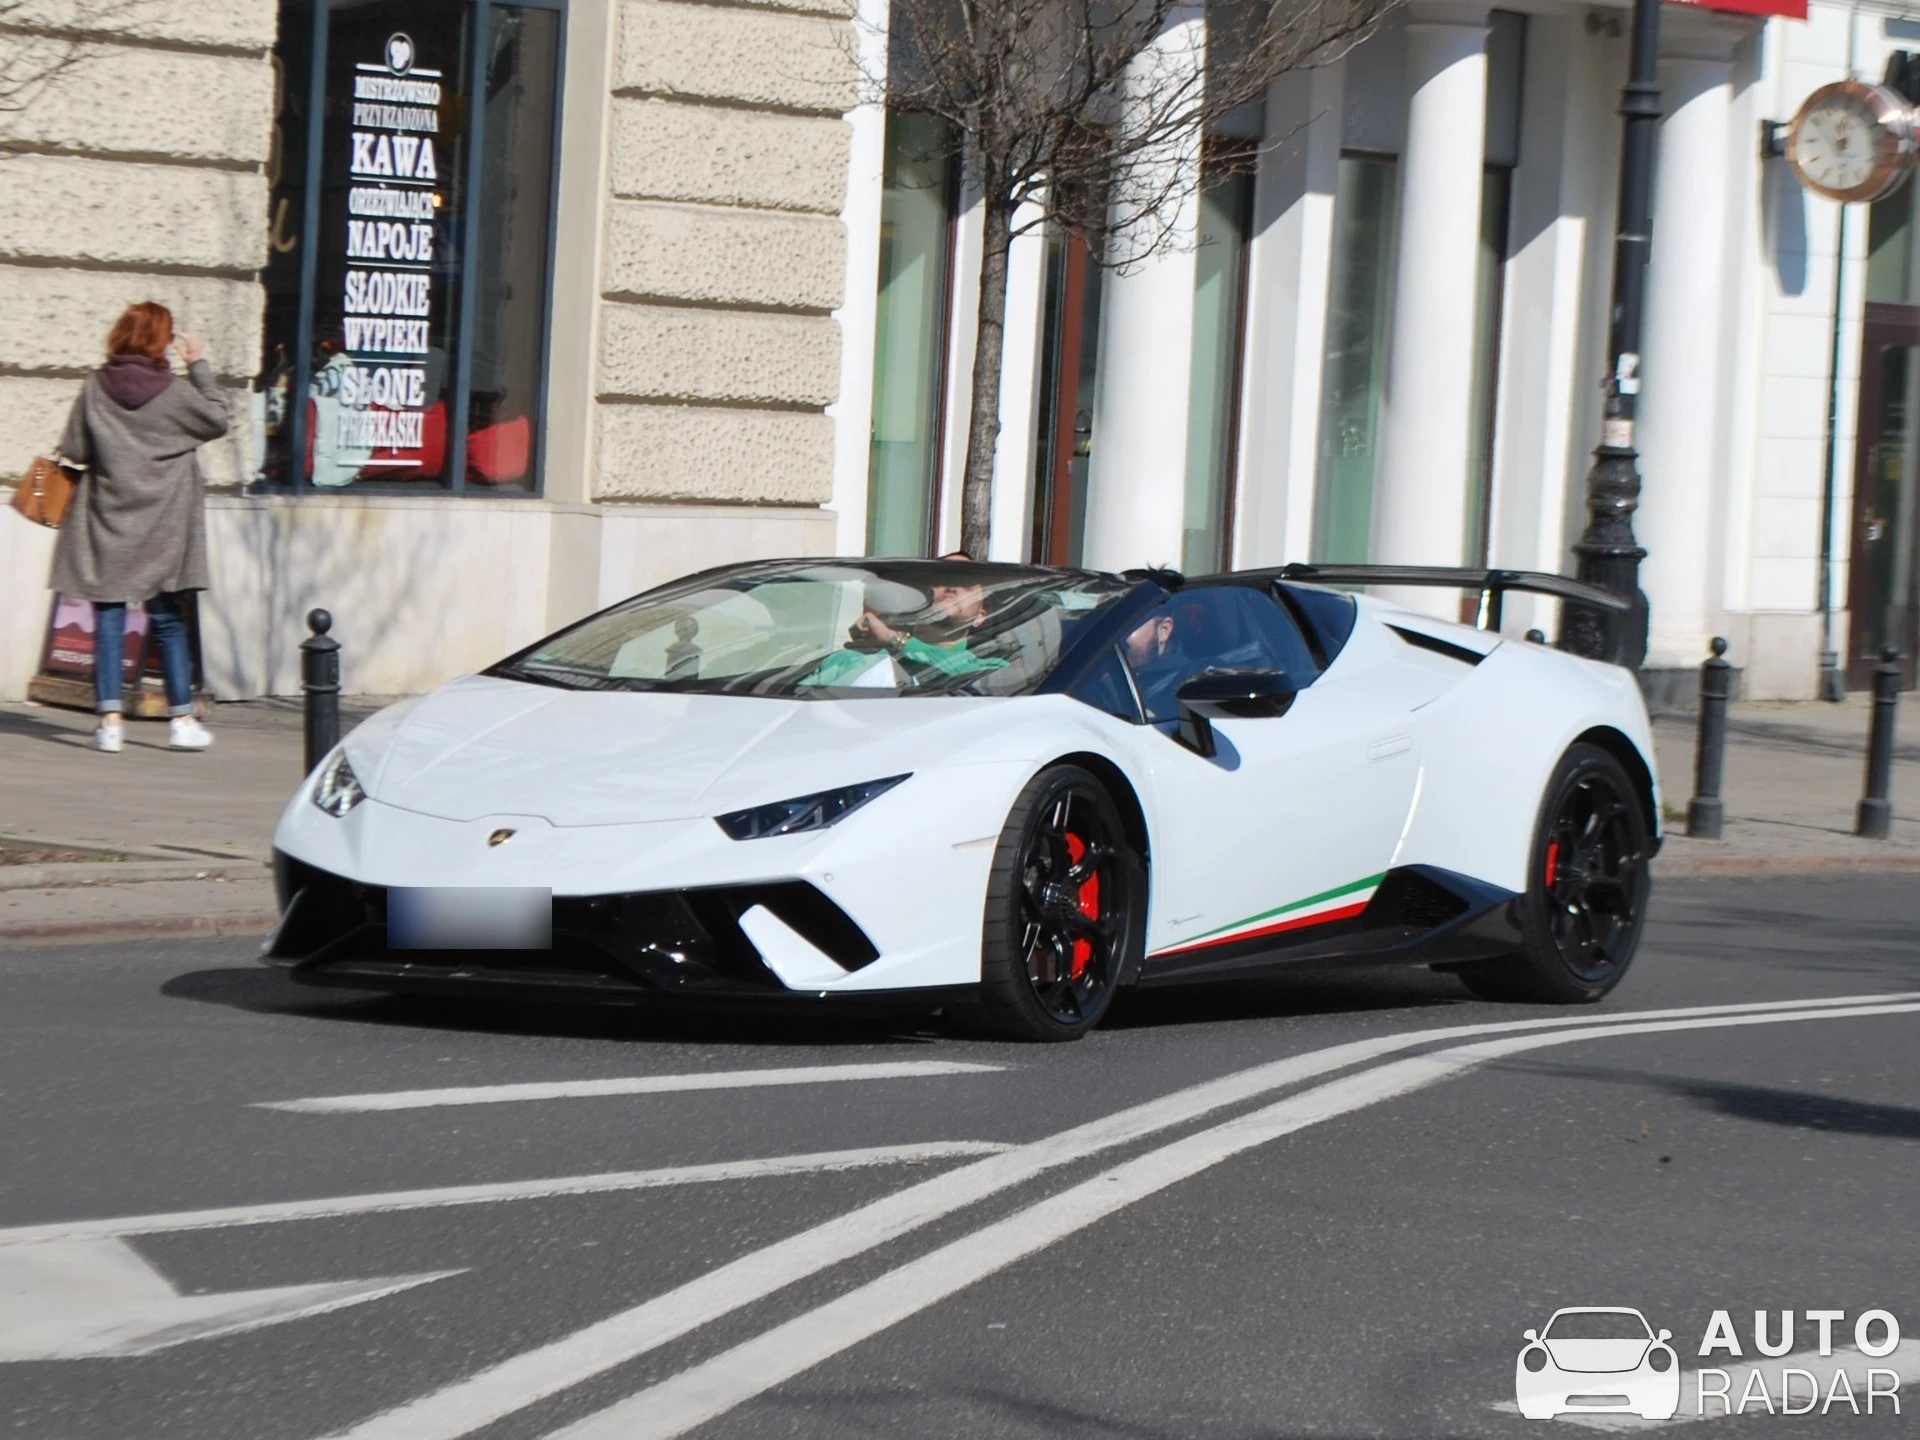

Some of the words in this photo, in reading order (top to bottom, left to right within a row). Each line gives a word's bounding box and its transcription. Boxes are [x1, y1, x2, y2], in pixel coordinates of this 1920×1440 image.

[351, 132, 437, 179] KAWA
[346, 220, 433, 260] NAPOJE
[344, 270, 430, 317] SŁODKIE
[343, 317, 429, 354] WYPIEKI
[340, 367, 425, 406] SŁONE
